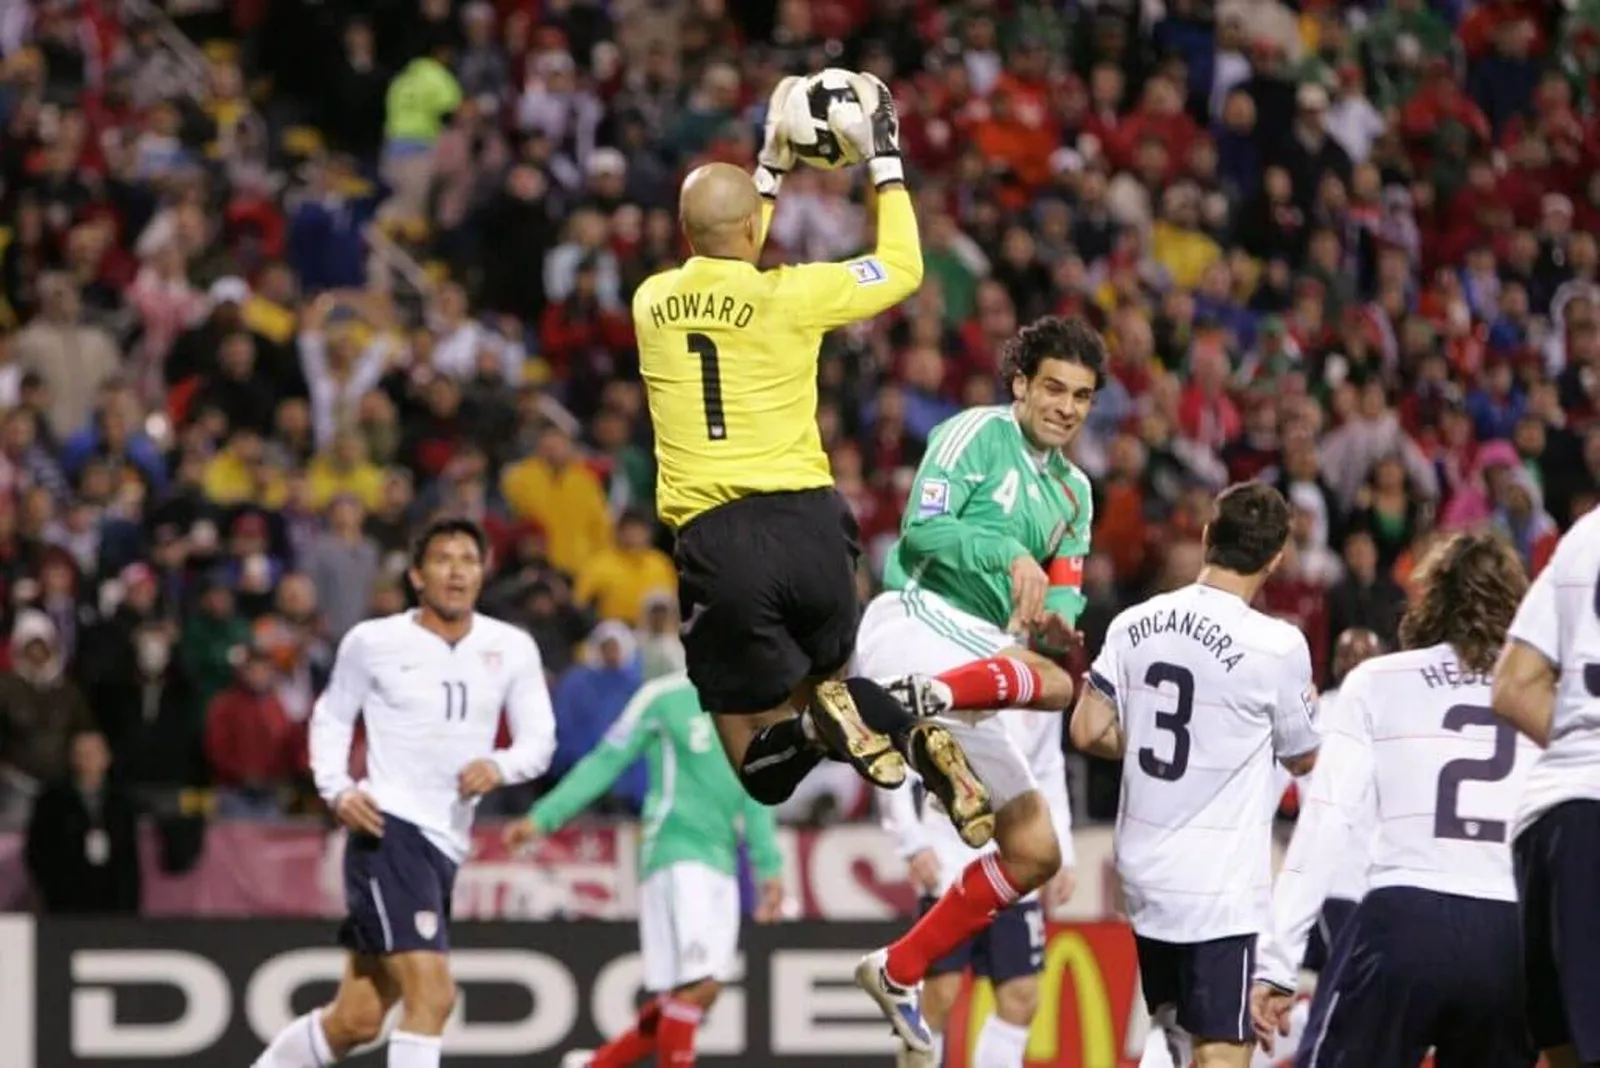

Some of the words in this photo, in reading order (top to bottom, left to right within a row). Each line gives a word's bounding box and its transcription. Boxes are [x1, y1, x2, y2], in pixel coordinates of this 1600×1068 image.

[650, 292, 754, 329] HOWARD
[687, 333, 727, 440] 1
[991, 467, 1020, 515] 4
[1128, 609, 1245, 673] BOCANEGRA
[441, 681, 467, 721] 11
[1138, 661, 1195, 781] 3
[1434, 703, 1517, 843] 2
[70, 949, 898, 1057] DODGE
